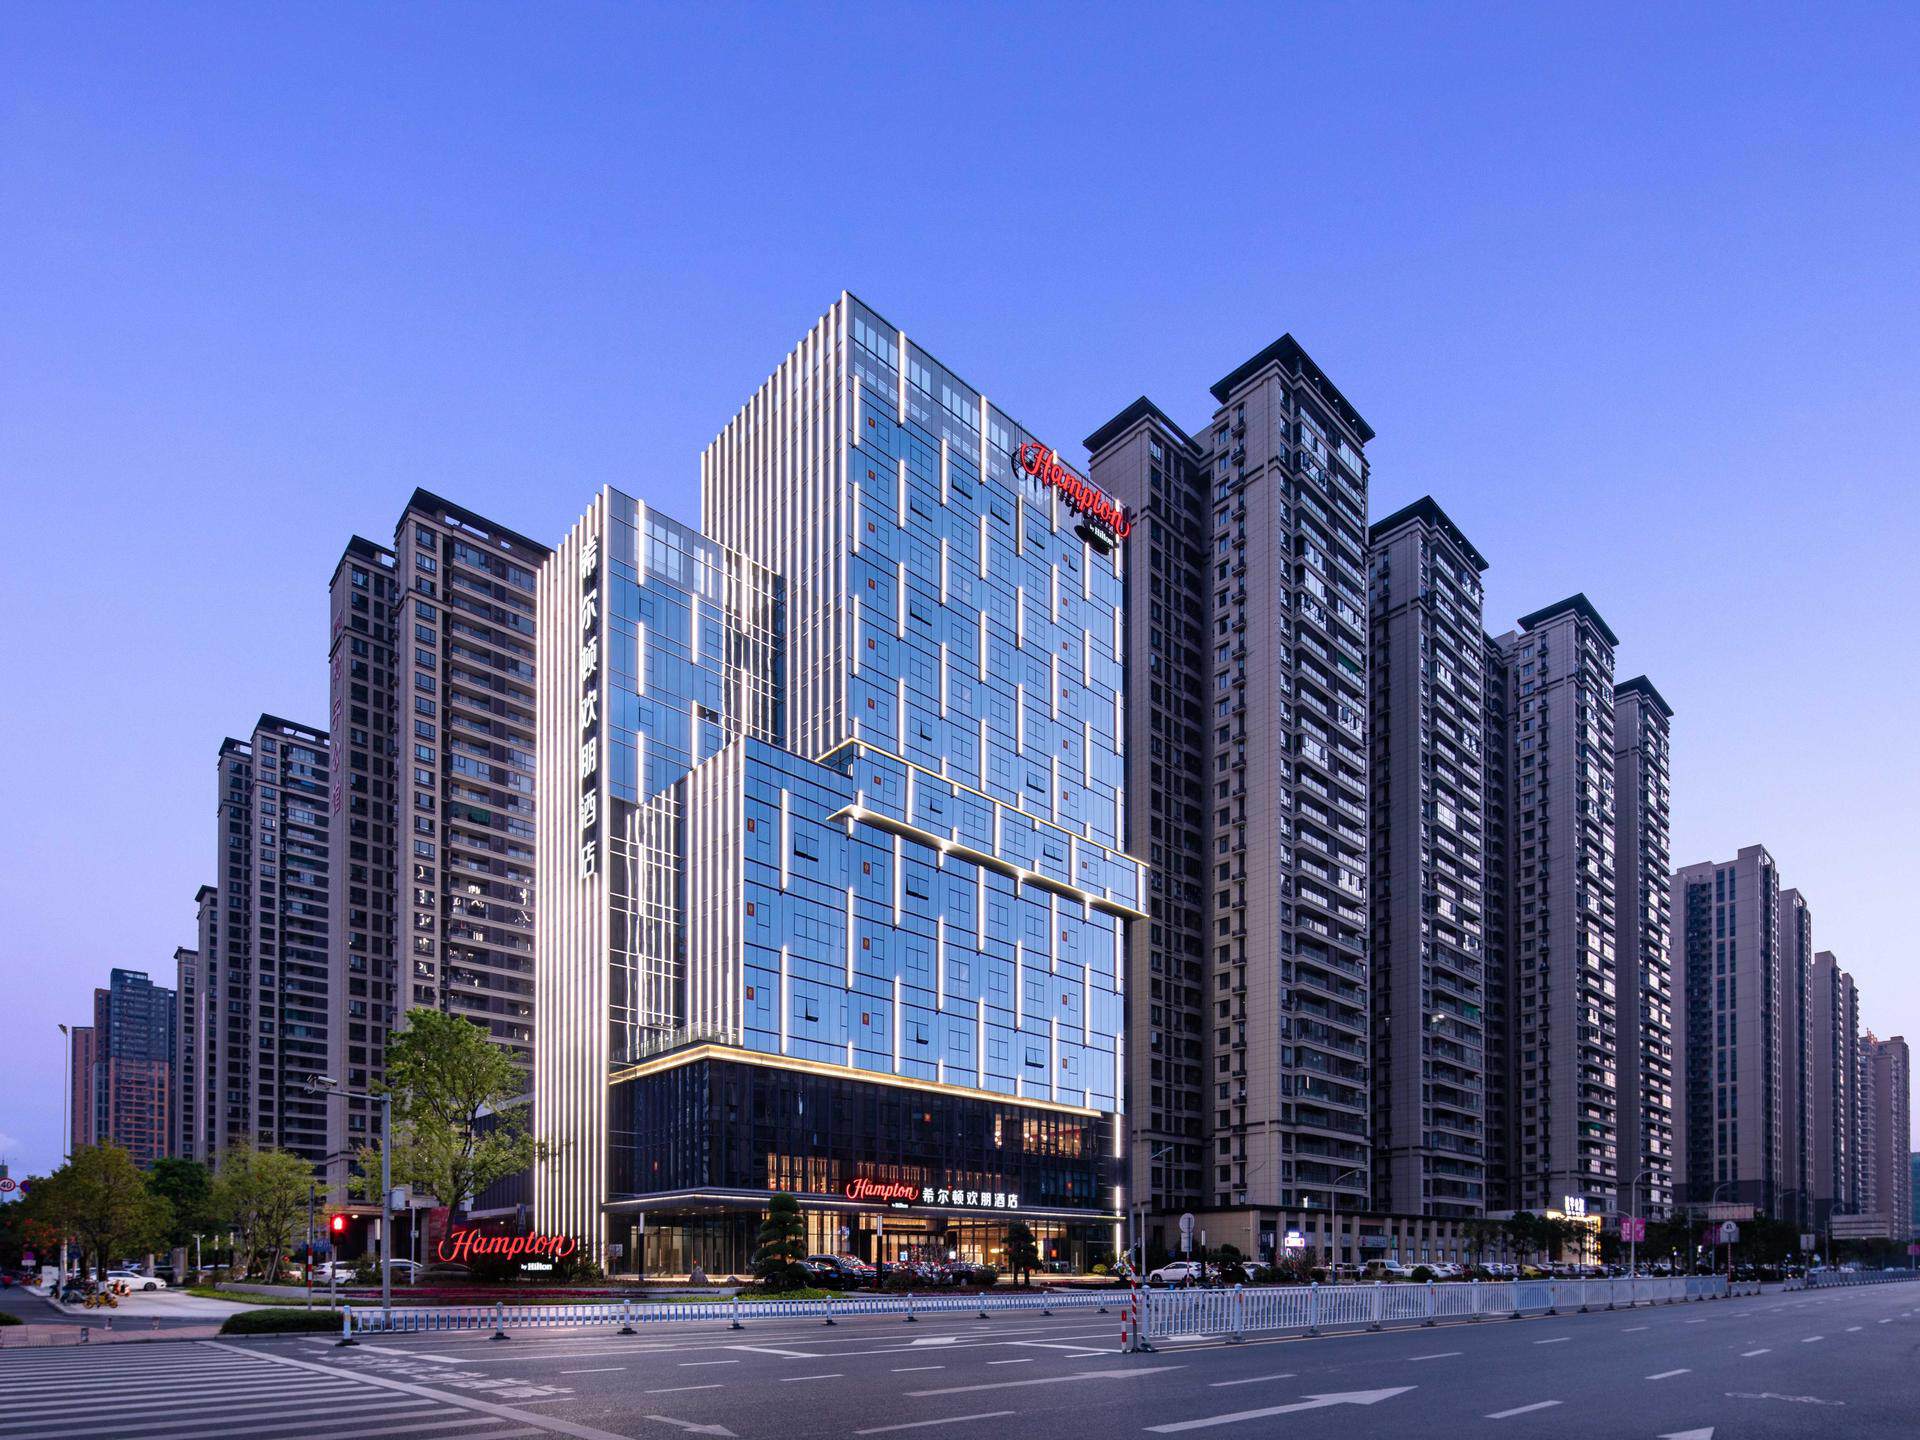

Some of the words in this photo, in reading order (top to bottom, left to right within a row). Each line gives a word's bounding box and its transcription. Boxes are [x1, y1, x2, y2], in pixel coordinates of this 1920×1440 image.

[1020, 441, 1131, 537] Hampton
[1094, 526, 1114, 547] Hilton
[579, 535, 597, 880] 希尔顿欢朋酒店
[1, 1181, 12, 1189] 40
[846, 1178, 919, 1200] Hampton
[922, 1187, 1018, 1208] 希尔顿欢朋酒店
[438, 1229, 575, 1261] Hampton
[528, 1262, 553, 1271] Hilton
